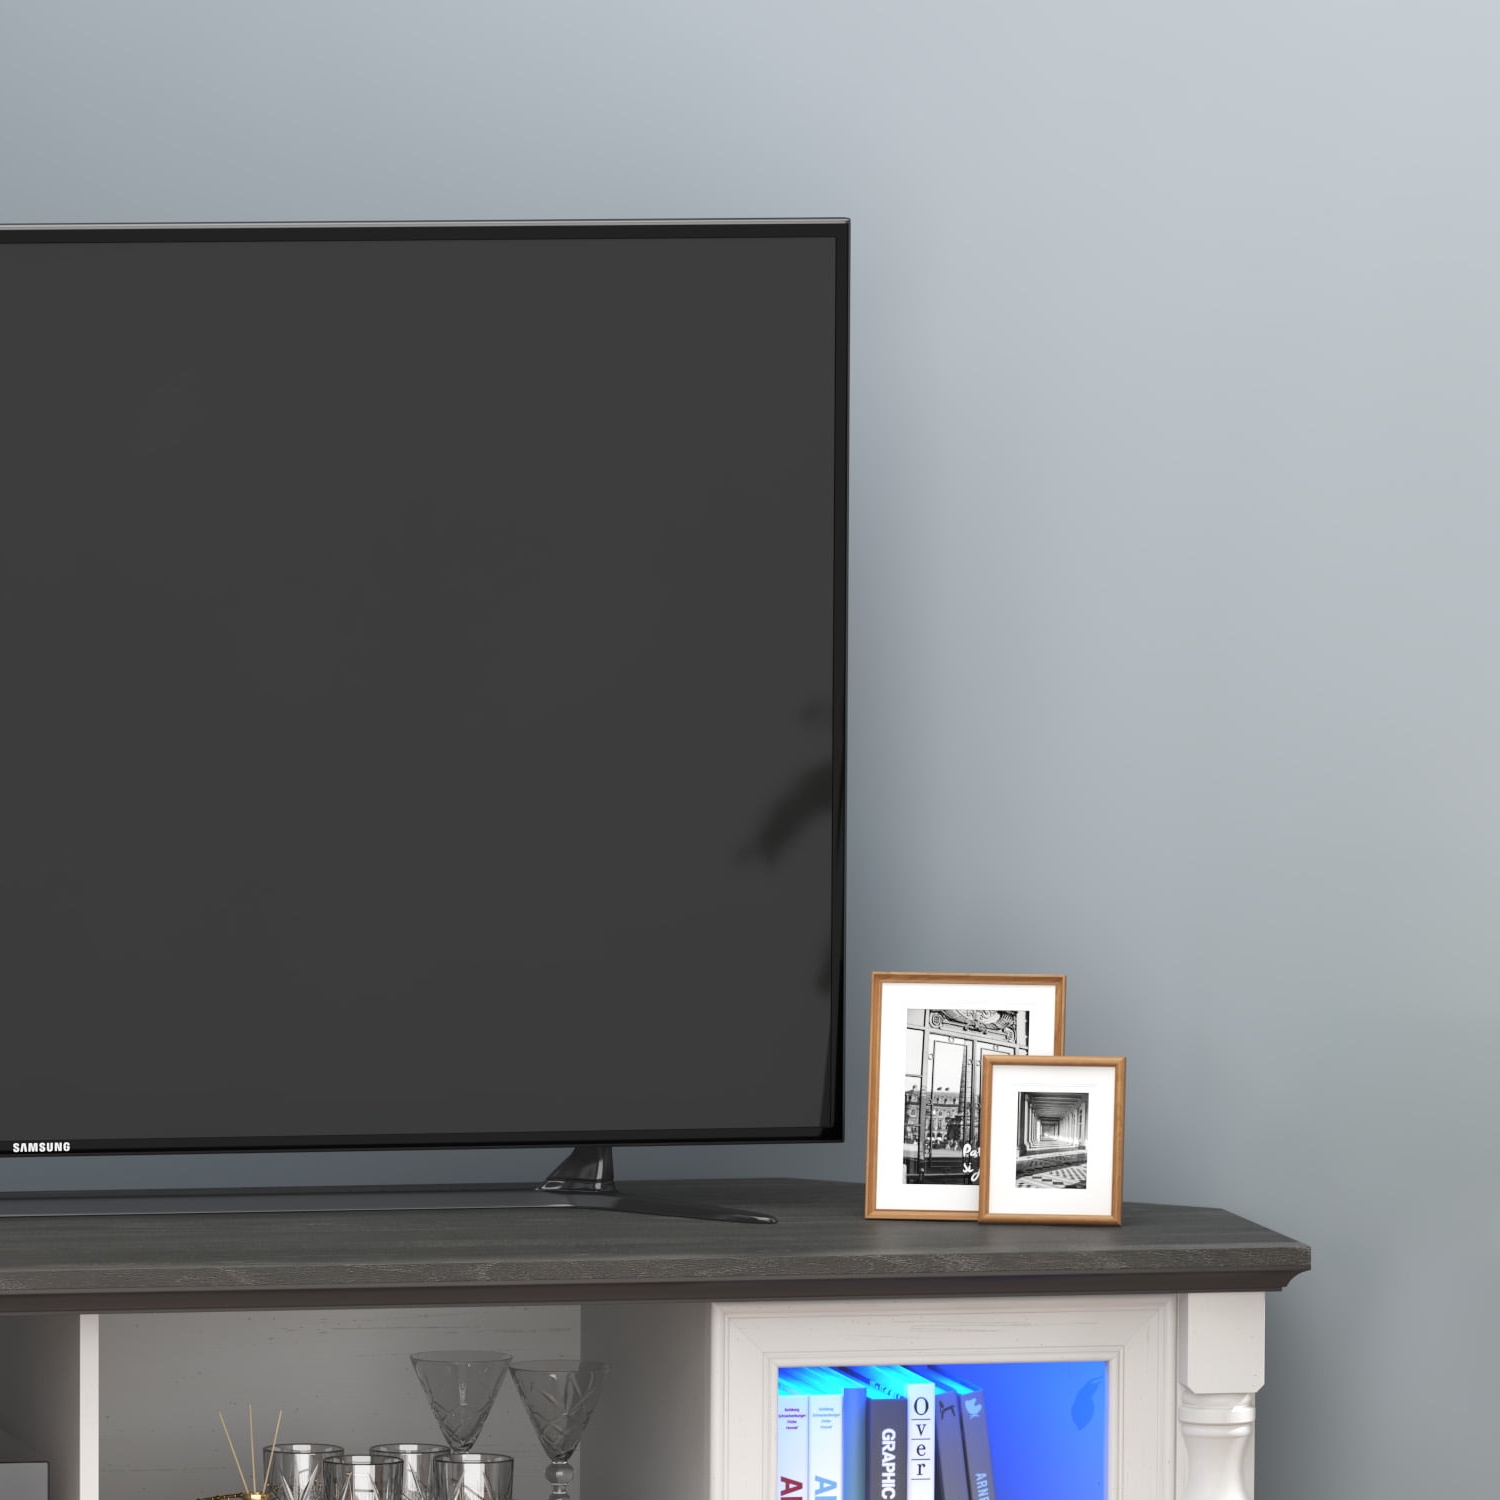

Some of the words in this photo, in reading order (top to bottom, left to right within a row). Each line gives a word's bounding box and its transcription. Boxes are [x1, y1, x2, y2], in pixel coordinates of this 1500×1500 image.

[12, 1141, 71, 1153] SAMSUNG
[881, 1428, 897, 1500] GRAPHIC
[913, 1396, 930, 1476] Over
